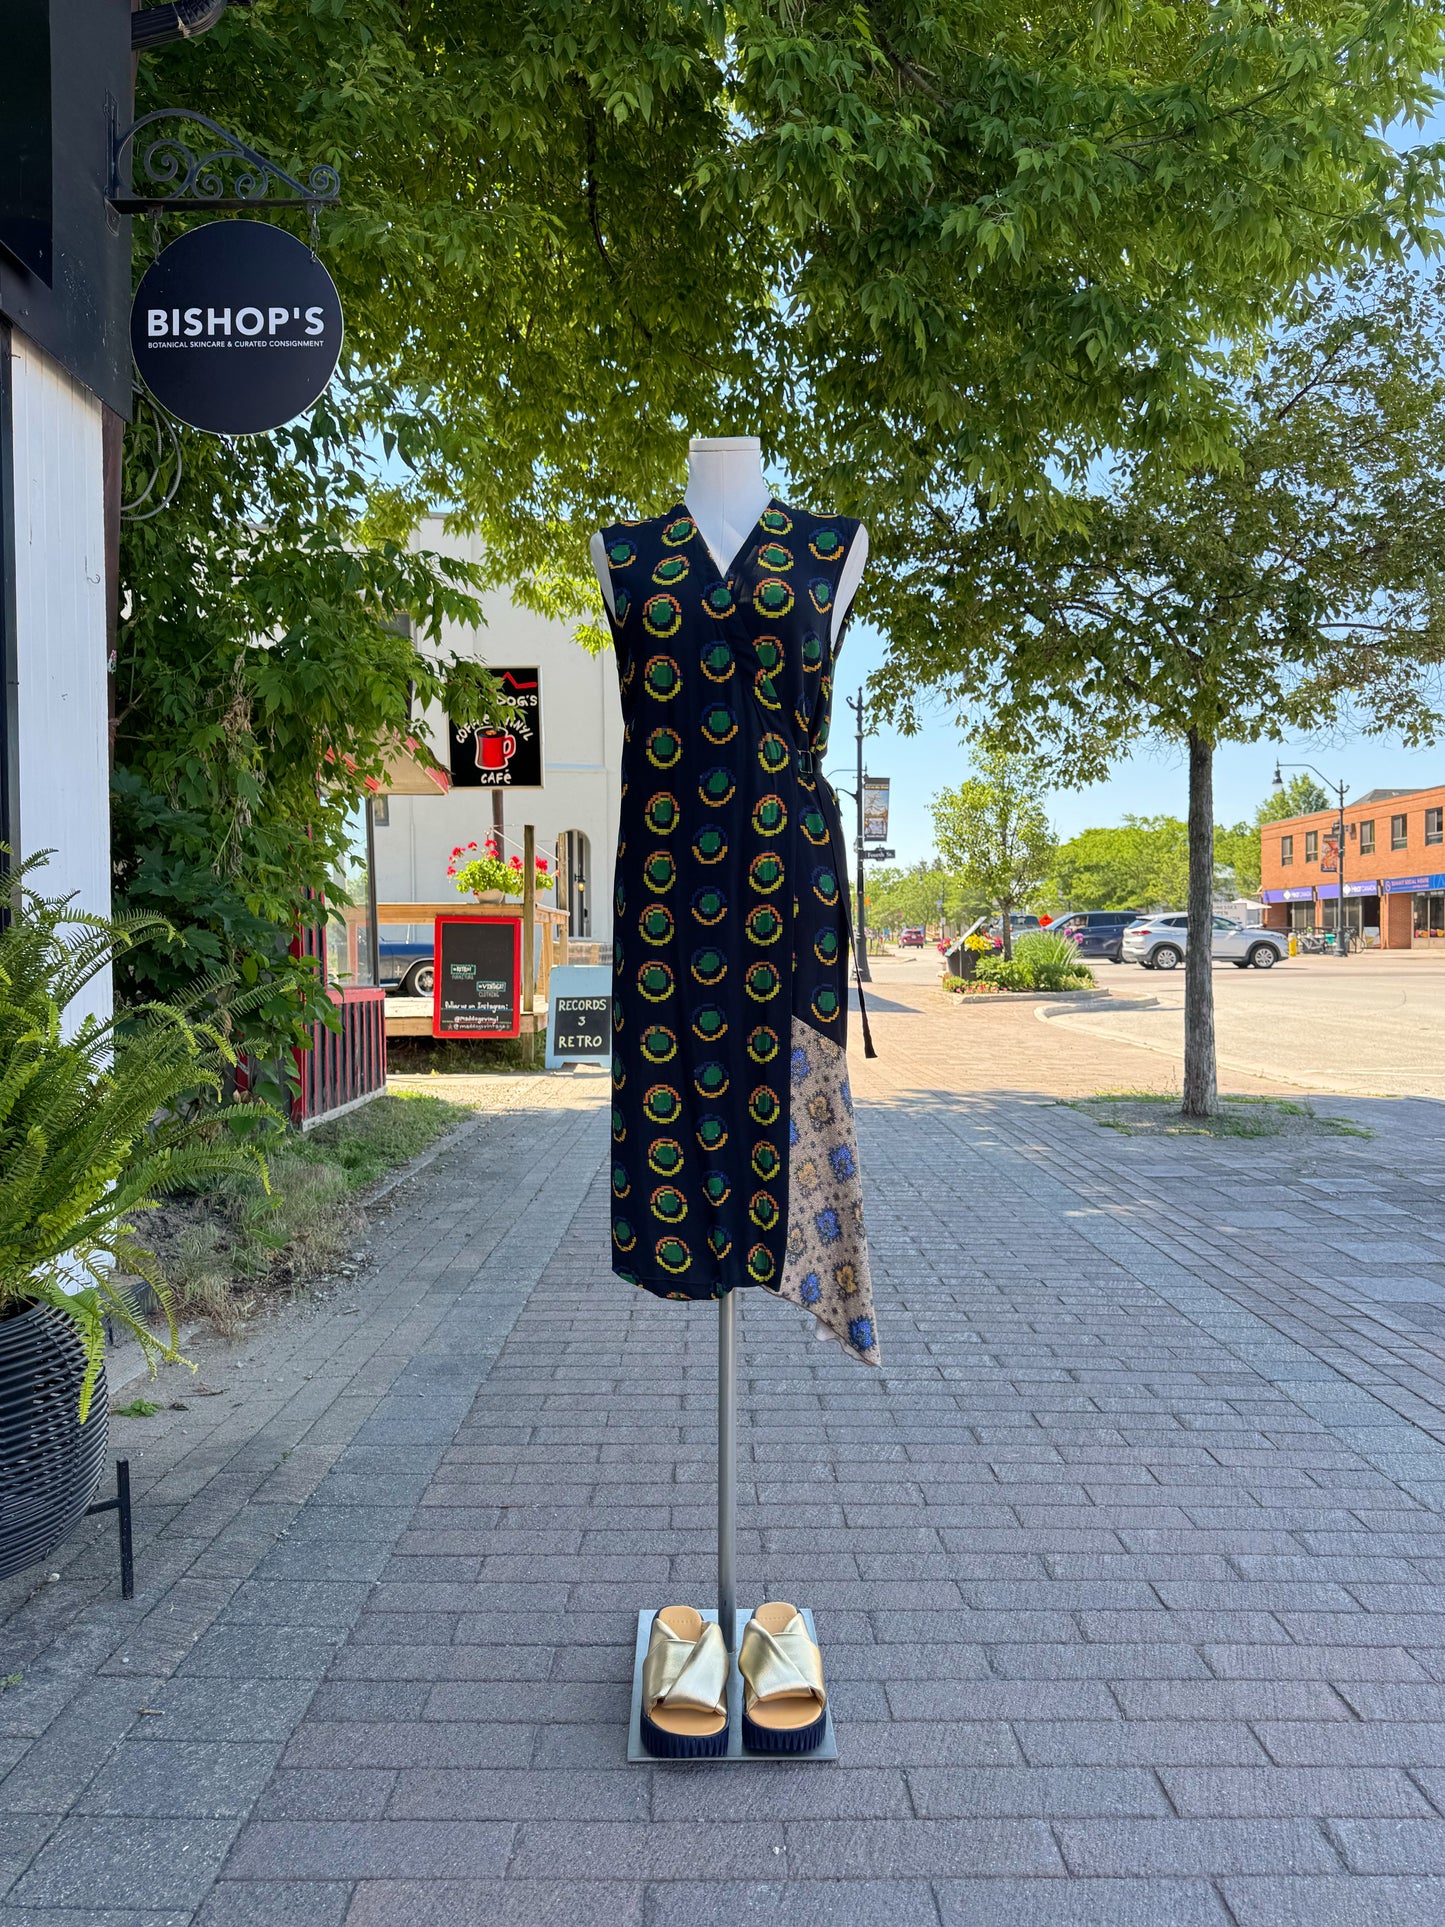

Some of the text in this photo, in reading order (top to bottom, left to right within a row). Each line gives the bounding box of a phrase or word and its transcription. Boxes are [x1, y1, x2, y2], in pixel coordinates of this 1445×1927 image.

[148, 307, 325, 337] BISHOP'S
[148, 341, 188, 349] BOTANICAL
[269, 340, 324, 348] CONSIGNMENT
[558, 999, 607, 1012] RECORDS
[558, 1035, 603, 1048] RETRO
